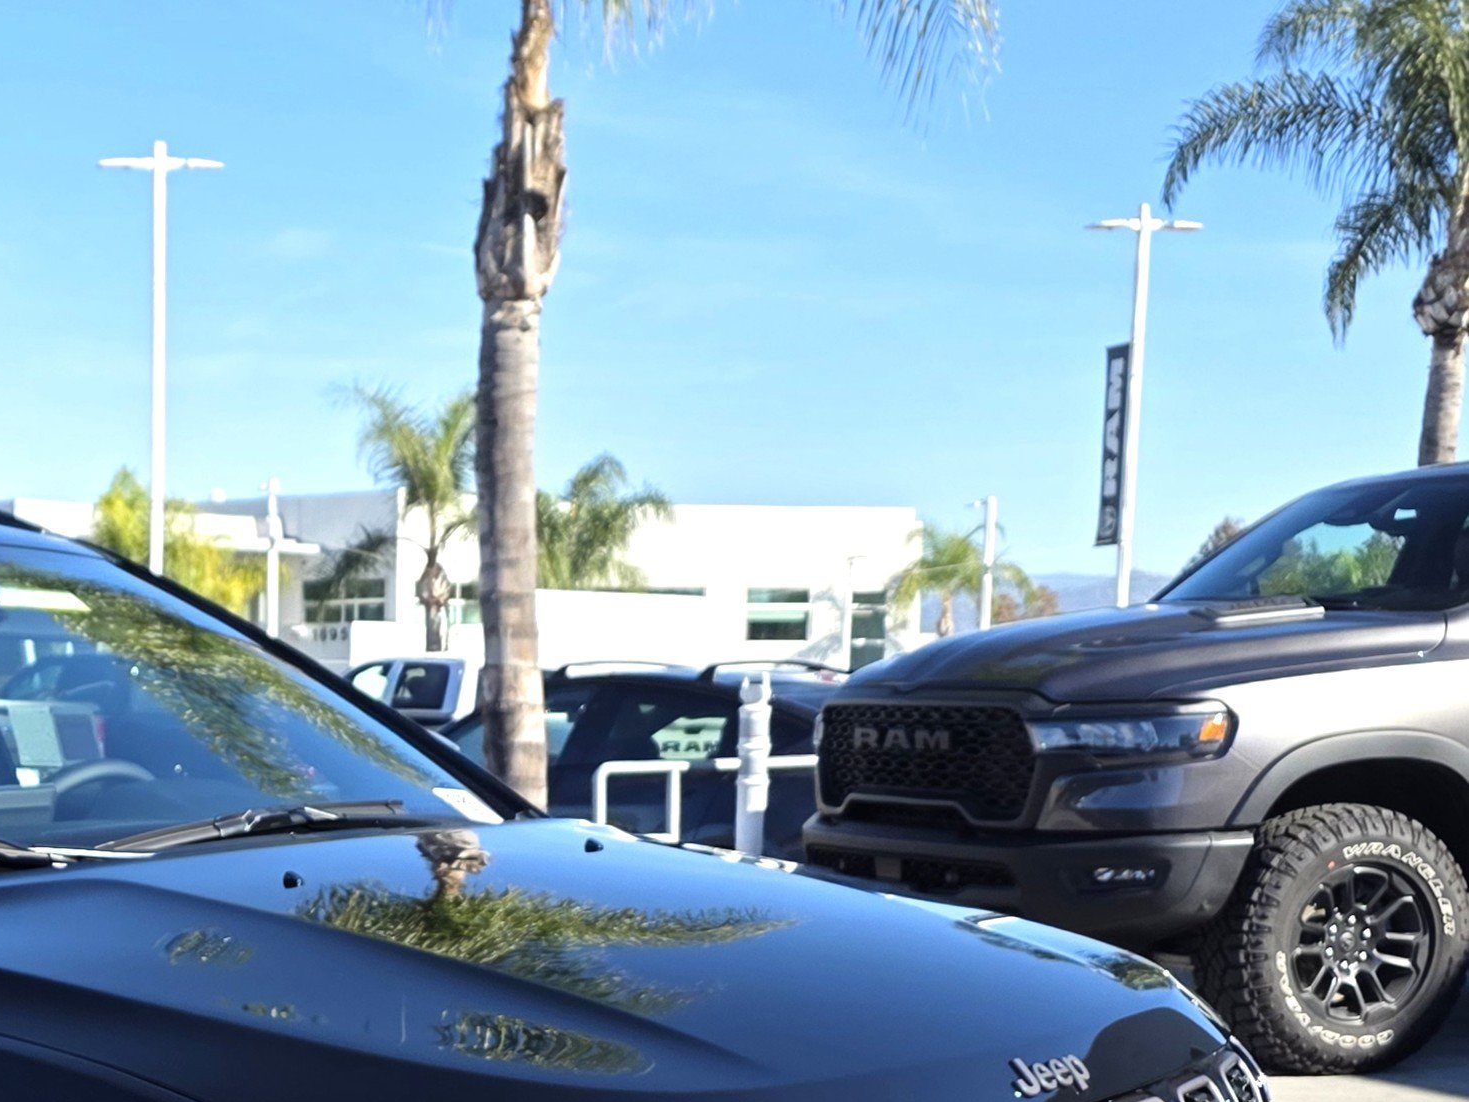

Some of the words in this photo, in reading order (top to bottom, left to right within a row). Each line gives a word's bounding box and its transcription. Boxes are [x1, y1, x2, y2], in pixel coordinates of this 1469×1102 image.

[1103, 357, 1125, 498] RAM
[854, 727, 950, 750] RAM
[1342, 842, 1456, 936] WRANGLER
[1275, 950, 1394, 1049] GOODYEAR
[1011, 1054, 1091, 1096] Jeep
